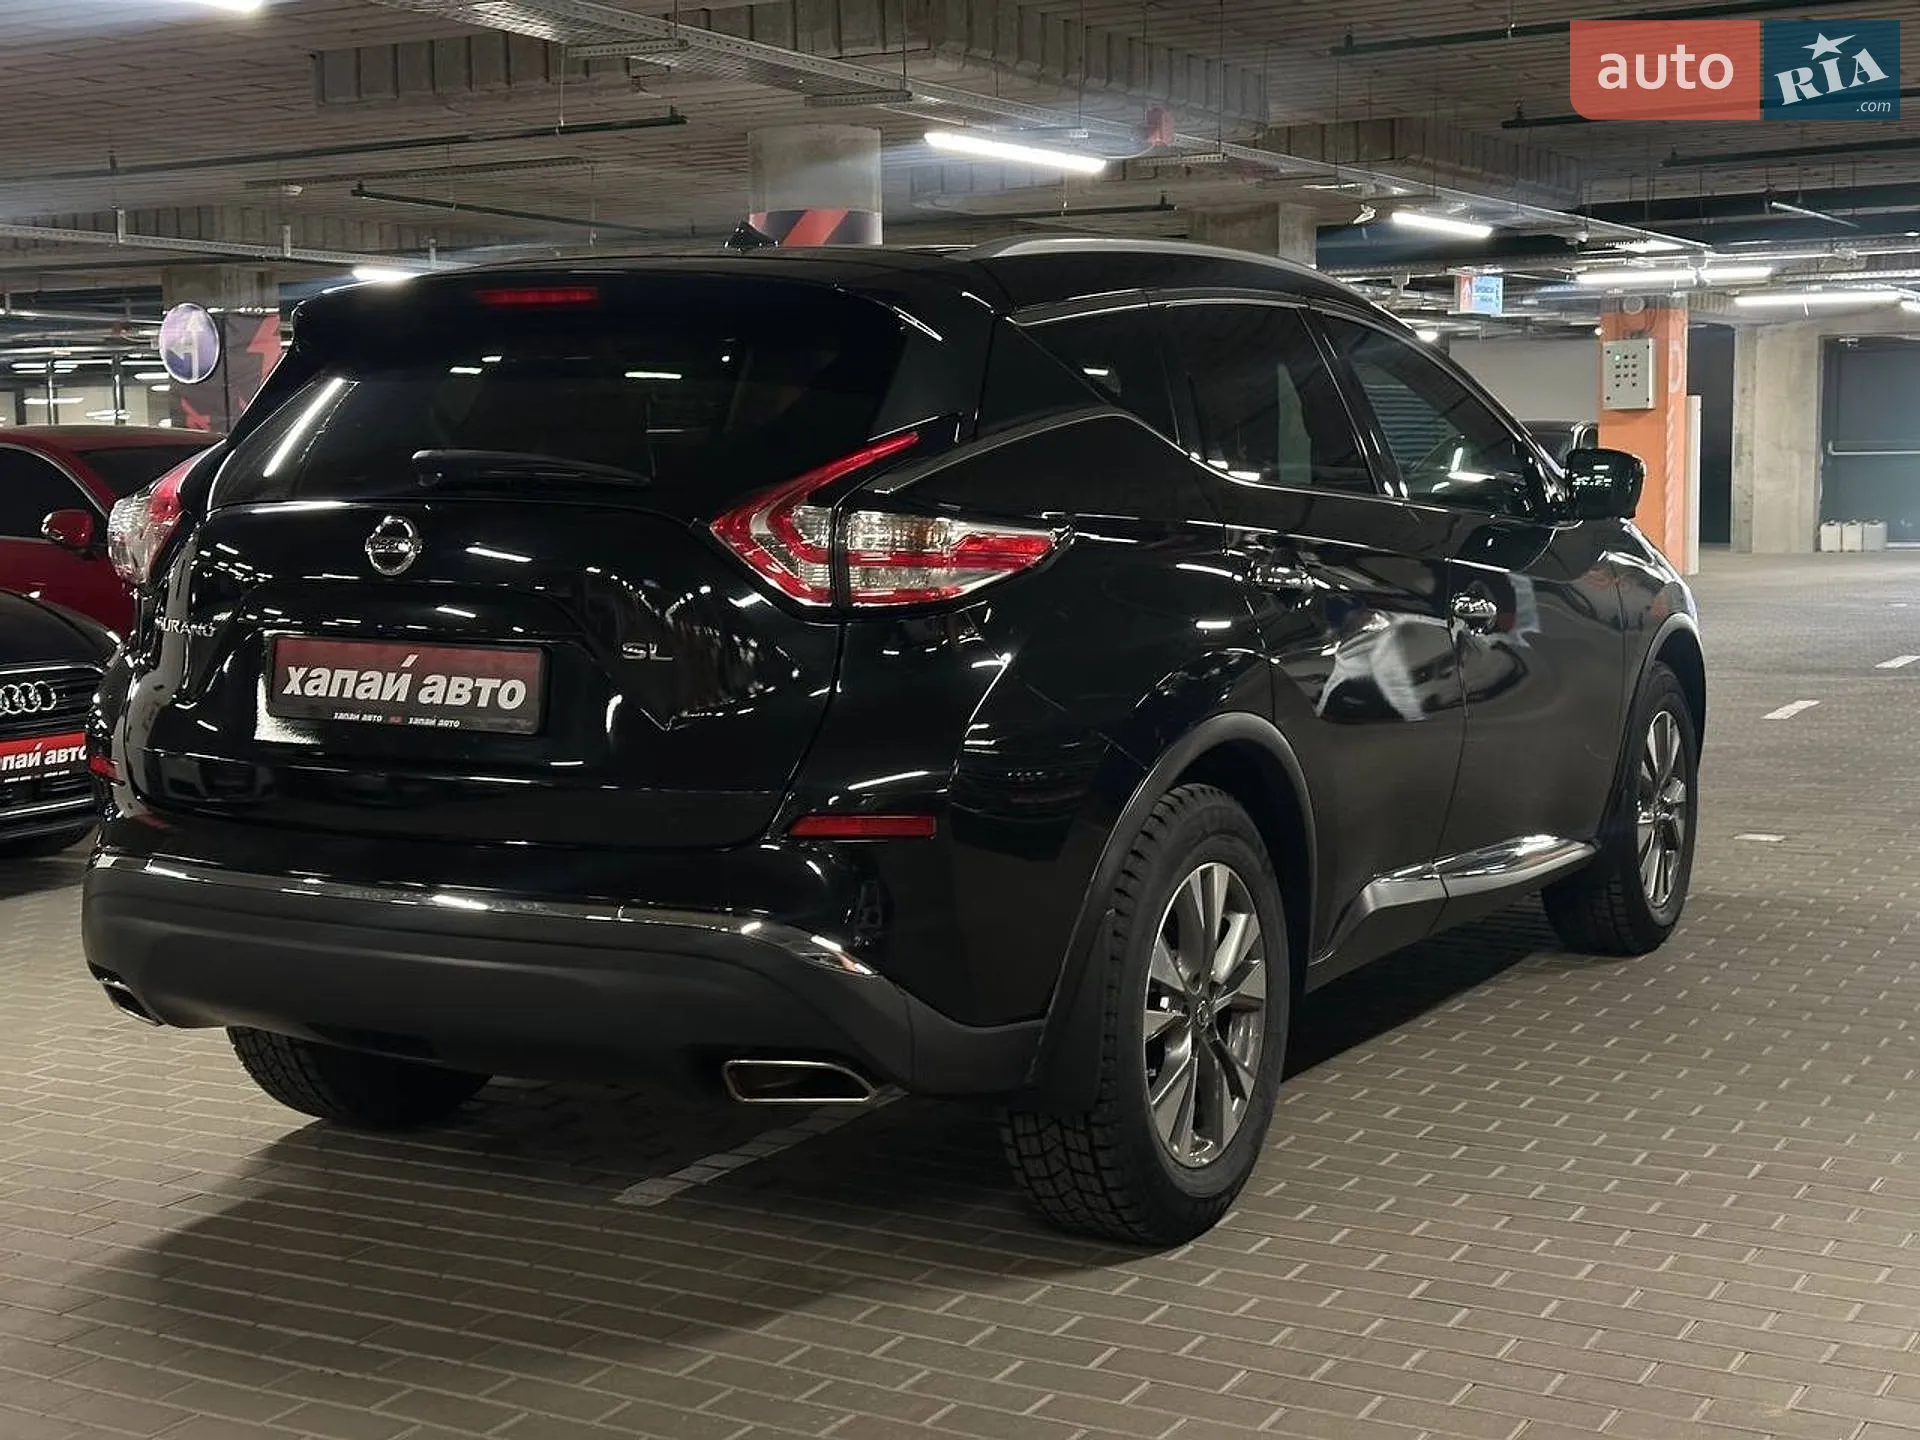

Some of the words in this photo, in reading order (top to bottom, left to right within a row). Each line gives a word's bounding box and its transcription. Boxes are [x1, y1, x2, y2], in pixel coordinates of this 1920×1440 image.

[622, 642, 673, 660] SL
[282, 654, 419, 702] хапай
[418, 674, 527, 710] авто
[0, 741, 44, 771] пай
